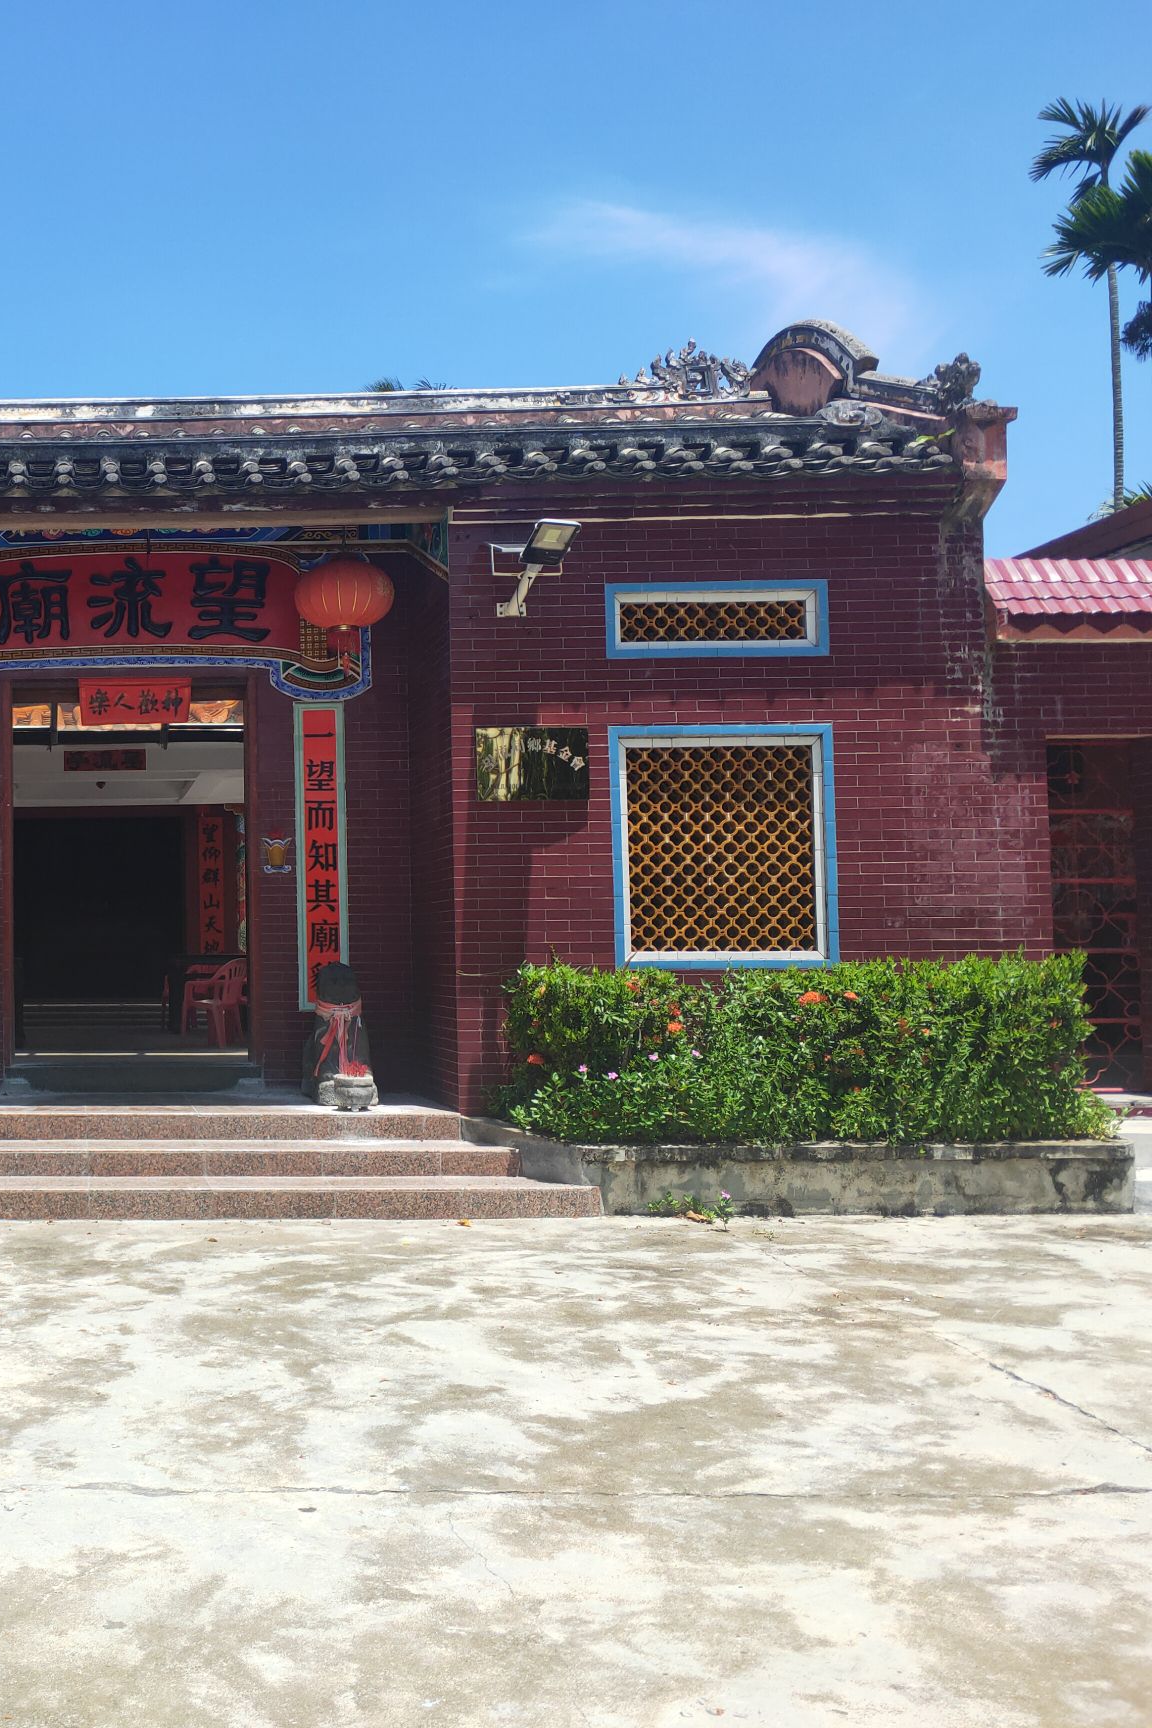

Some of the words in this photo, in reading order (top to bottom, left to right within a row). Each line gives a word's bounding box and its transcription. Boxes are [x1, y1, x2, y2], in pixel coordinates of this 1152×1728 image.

[88, 688, 184, 718] 神歡人樂
[303, 730, 341, 989] 一望而知其廟
